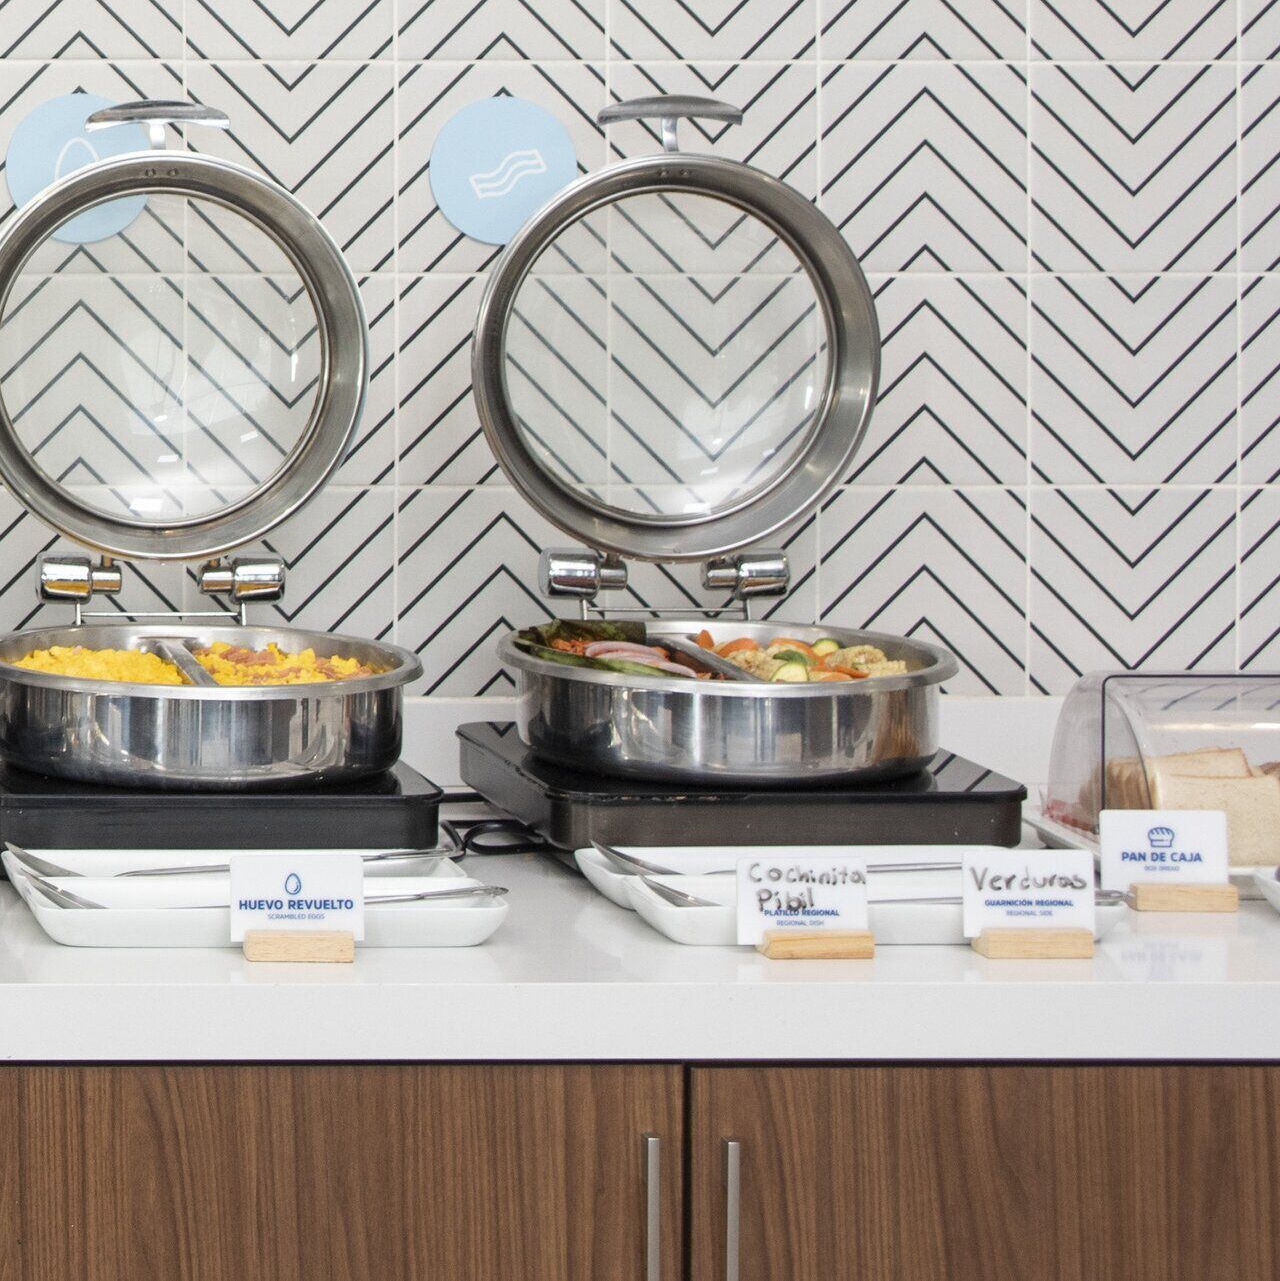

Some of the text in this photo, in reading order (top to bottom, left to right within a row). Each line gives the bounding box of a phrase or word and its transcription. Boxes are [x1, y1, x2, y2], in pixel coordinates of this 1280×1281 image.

[1121, 852, 1202, 863] PAN DE CAJA
[748, 863, 866, 886] Cochinita
[970, 866, 1087, 891] Verduras
[239, 899, 354, 910] HUEVO REVUELTO
[756, 887, 815, 912] Pibil
[984, 898, 1074, 907] GUARNICIÓN REGIONAL
